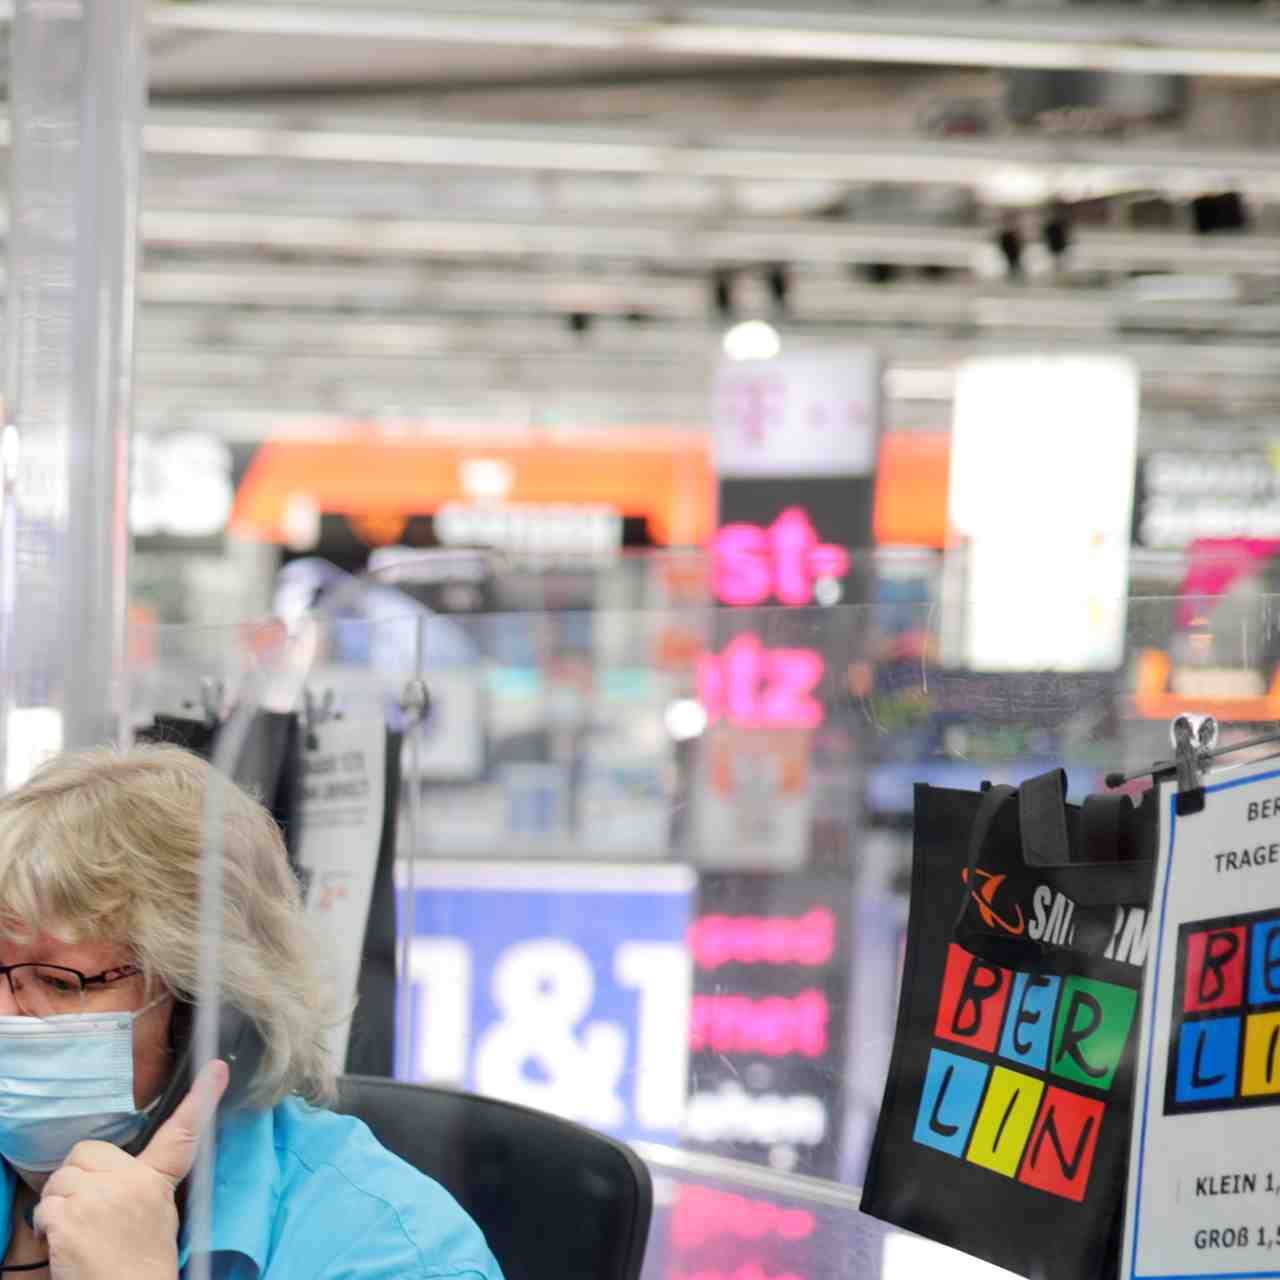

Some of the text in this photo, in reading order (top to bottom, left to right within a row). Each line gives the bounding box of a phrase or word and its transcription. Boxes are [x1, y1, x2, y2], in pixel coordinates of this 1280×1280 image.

[408, 937, 688, 1130] 1&1
[928, 1065, 1095, 1180] LIN
[1195, 1174, 1257, 1197] KLEIN
